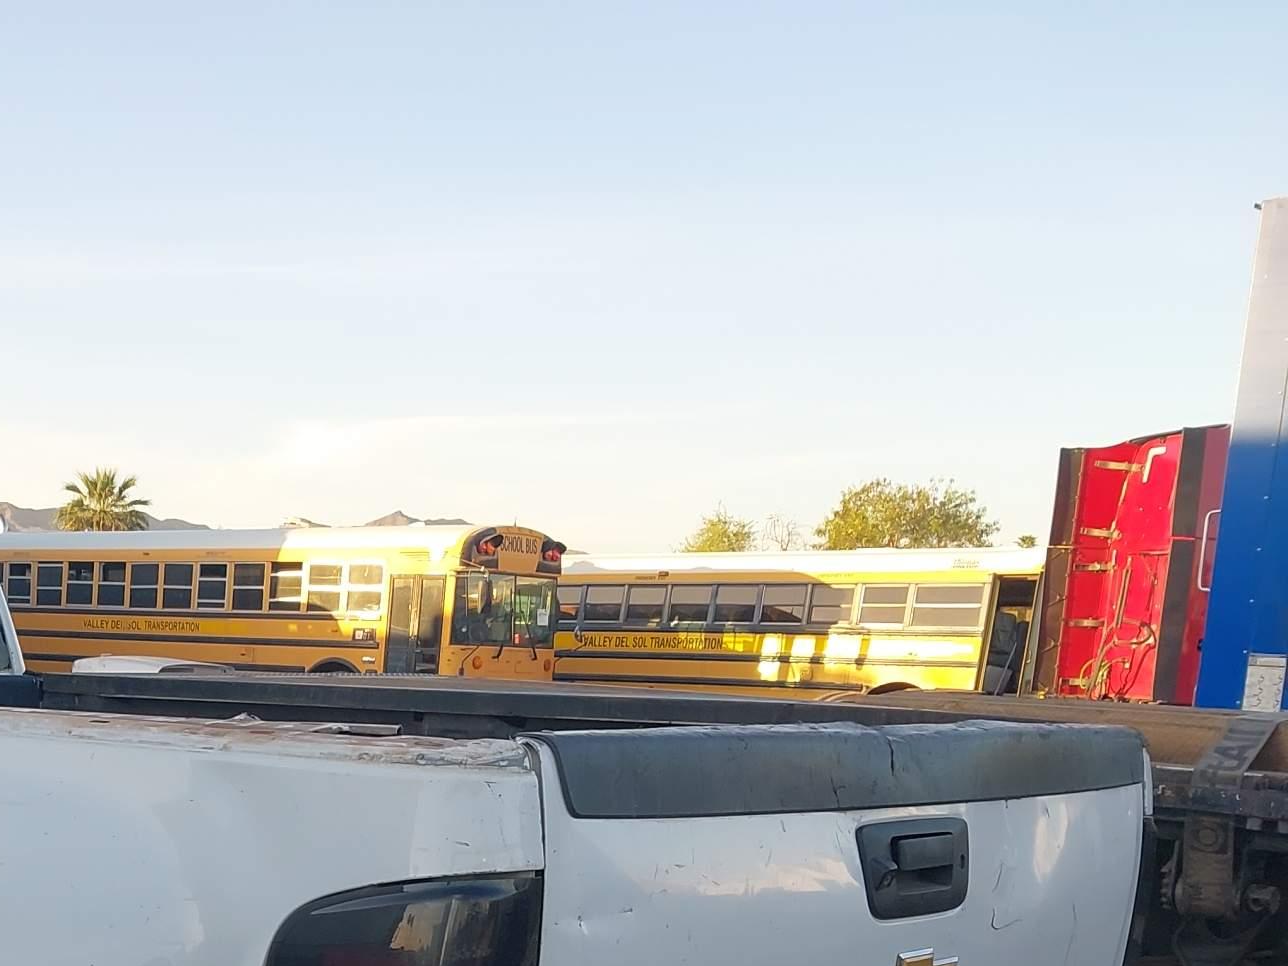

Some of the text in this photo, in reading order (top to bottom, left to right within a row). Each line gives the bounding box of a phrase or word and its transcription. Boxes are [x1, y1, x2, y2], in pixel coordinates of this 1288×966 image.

[500, 535, 538, 554] SCHOOL BUS
[83, 619, 109, 629] VALLEY
[144, 620, 200, 632] TRANSPORTATION
[583, 634, 723, 650] VALLEY DEL SOL TRANSPORTATION
